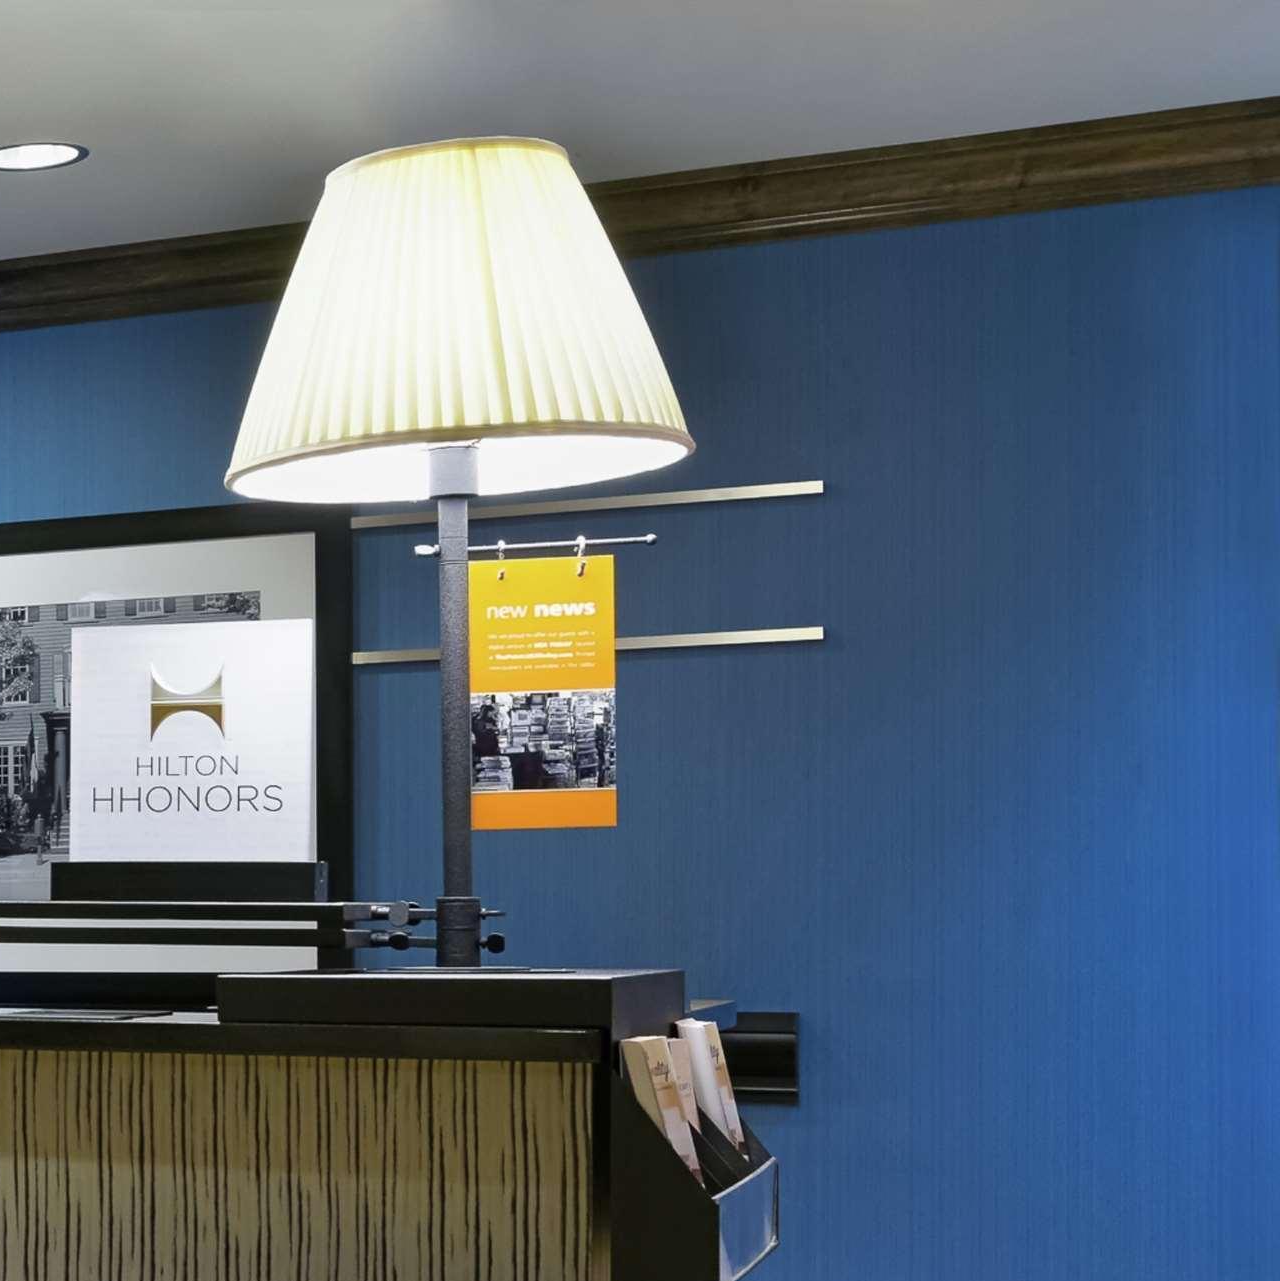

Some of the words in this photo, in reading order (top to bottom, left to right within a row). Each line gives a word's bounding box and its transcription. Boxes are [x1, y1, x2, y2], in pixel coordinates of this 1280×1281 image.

[486, 604, 528, 619] new
[533, 601, 596, 618] news
[136, 754, 240, 777] HILTON
[92, 784, 284, 813] HHONORS
